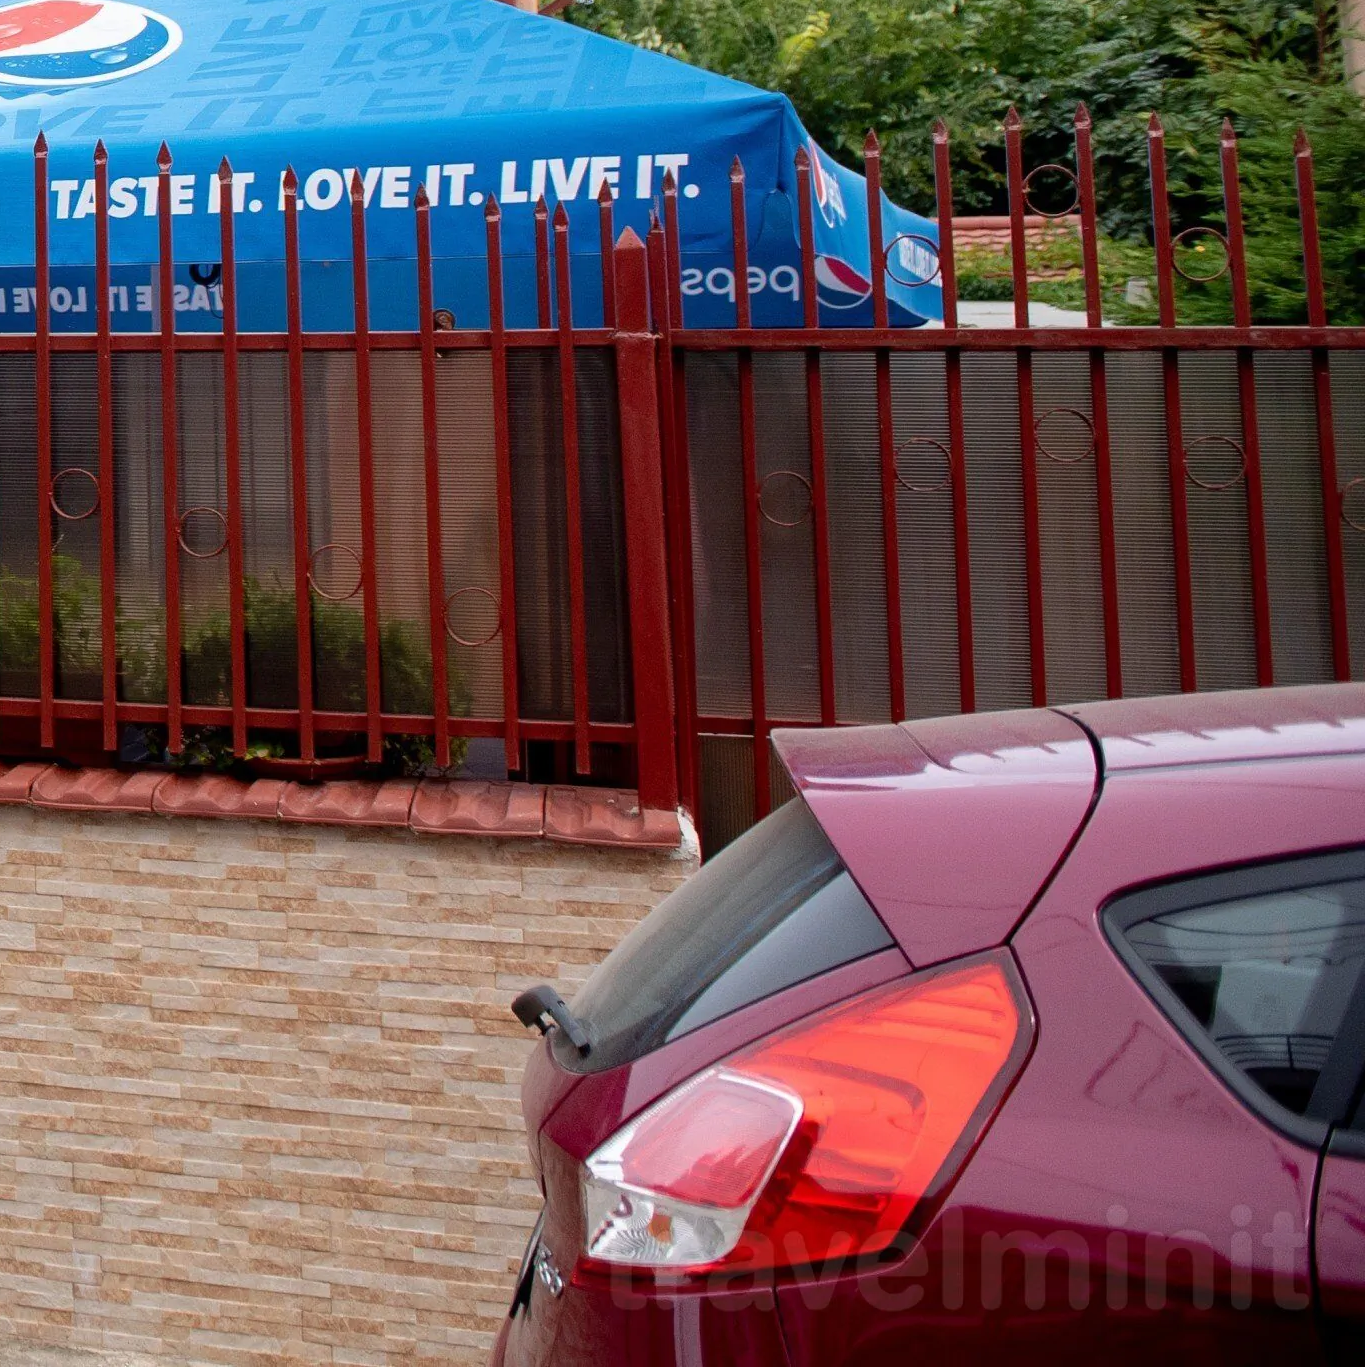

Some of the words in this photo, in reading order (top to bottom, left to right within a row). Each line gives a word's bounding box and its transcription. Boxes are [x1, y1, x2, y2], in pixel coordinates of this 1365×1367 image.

[51, 175, 195, 219] TASTE
[207, 172, 263, 214] IT.
[278, 166, 411, 211] LOVE
[424, 163, 484, 207] IT.
[500, 156, 621, 204] LIVE
[635, 153, 700, 199] IT.
